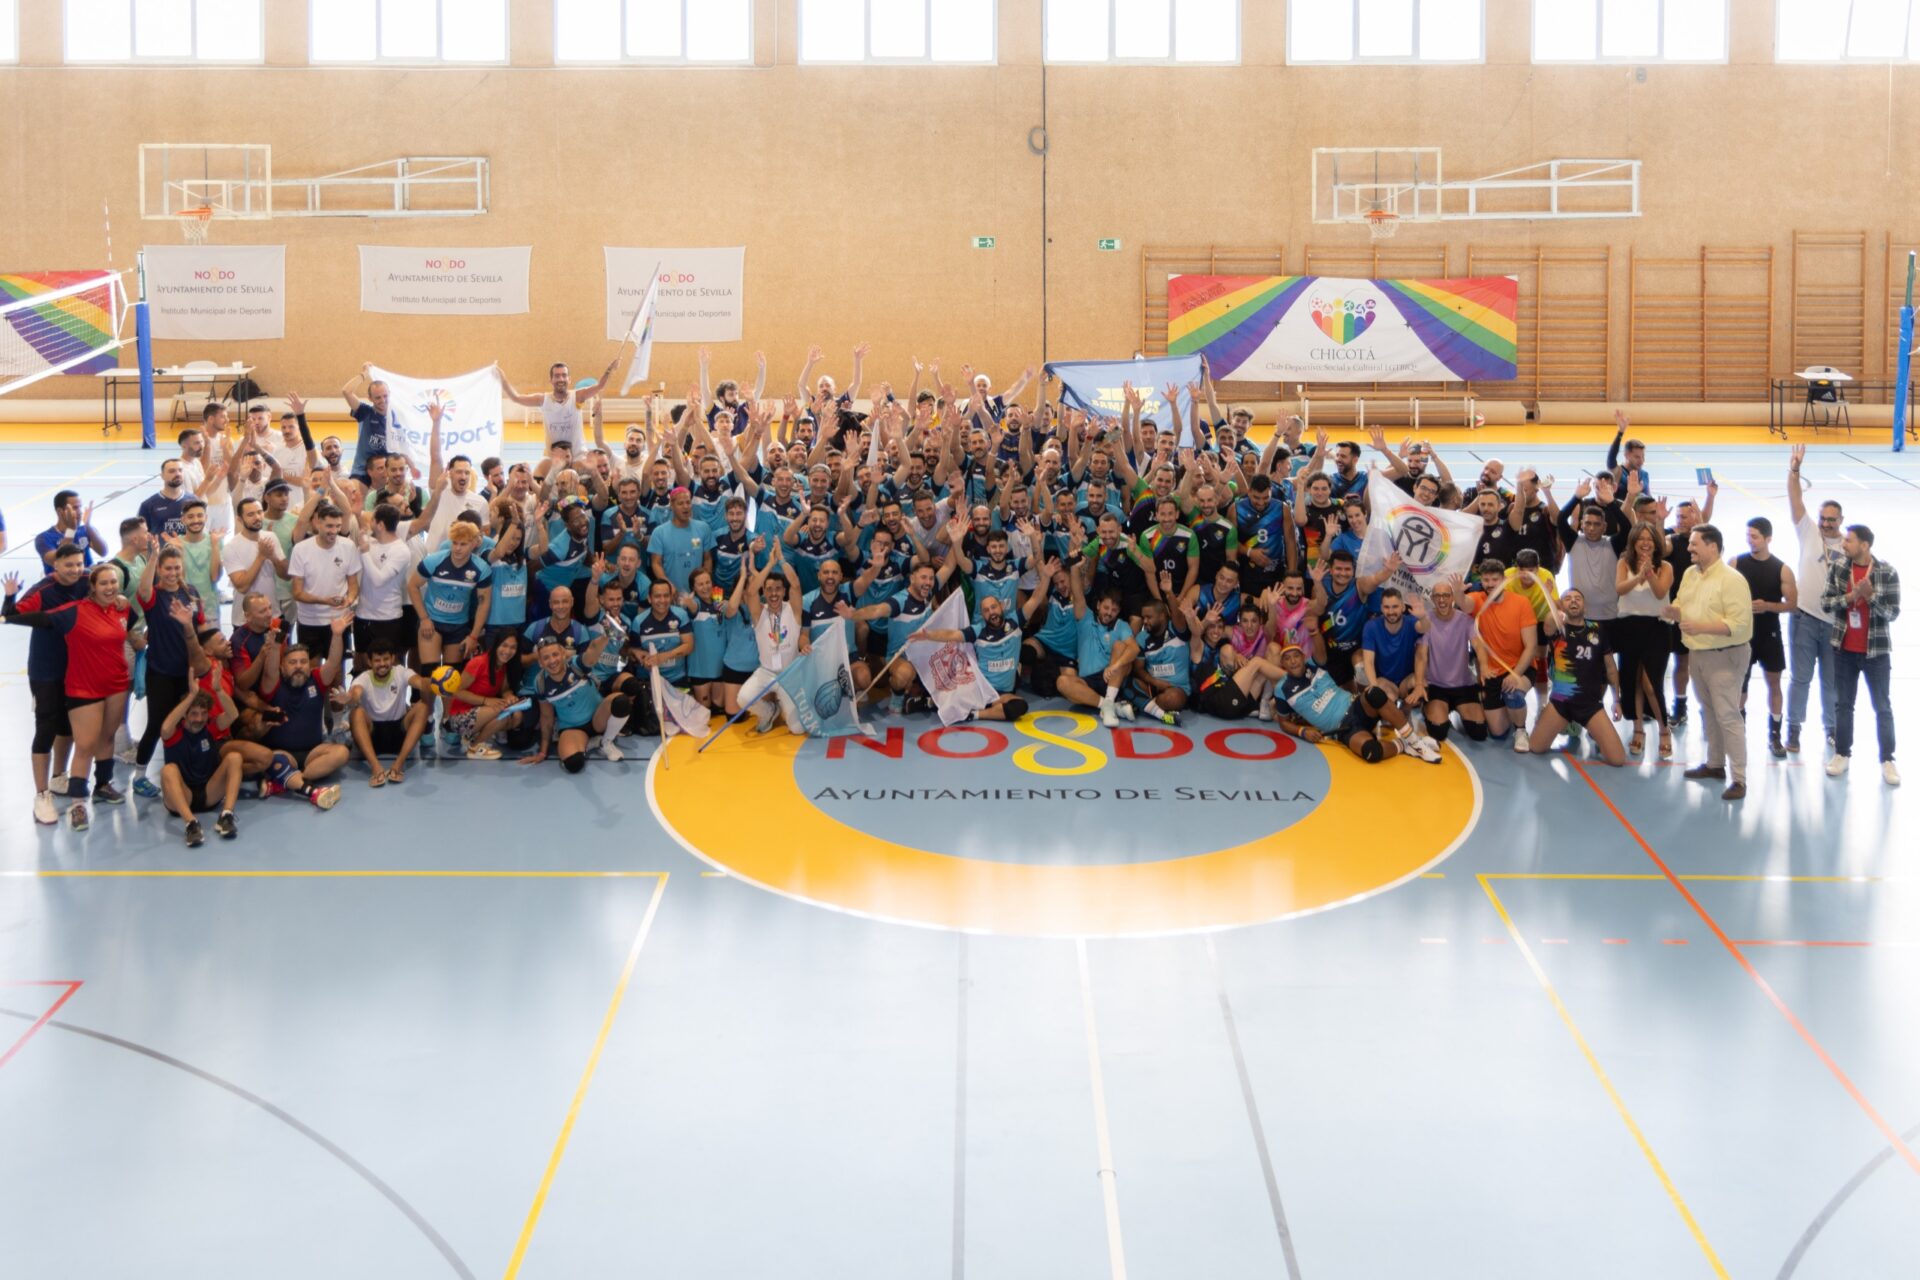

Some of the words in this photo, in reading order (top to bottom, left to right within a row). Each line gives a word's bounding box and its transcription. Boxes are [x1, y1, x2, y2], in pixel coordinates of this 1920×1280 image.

[456, 274, 468, 283] DE
[470, 273, 504, 283] SEVILLA
[226, 285, 238, 294] DE
[240, 284, 274, 294] SEVILLA
[685, 288, 698, 297] DE
[699, 287, 733, 297] SEVILLA
[391, 296, 420, 304] Instituto
[421, 296, 457, 305] Municipal
[458, 296, 467, 304] de
[469, 296, 502, 305] Deportes
[160, 307, 189, 315] Instituto
[190, 307, 226, 316] Municipal
[227, 307, 237, 315] de
[239, 307, 272, 316] Deportes
[687, 309, 697, 318] de
[698, 309, 731, 319] Deportes
[1310, 345, 1376, 360] CHICOTÁ
[1265, 361, 1284, 370] Club
[1323, 363, 1346, 372] Social
[1353, 362, 1383, 372] Cultural
[1256, 528, 1269, 543] 8
[1482, 542, 1490, 554] 3
[1163, 559, 1176, 570] 10
[1328, 609, 1348, 627] 16
[1575, 645, 1592, 660] 24
[814, 786, 1102, 801] AYUNTAMIENTO
[1115, 788, 1161, 801] DE
[1174, 786, 1316, 802] SEVILLA
